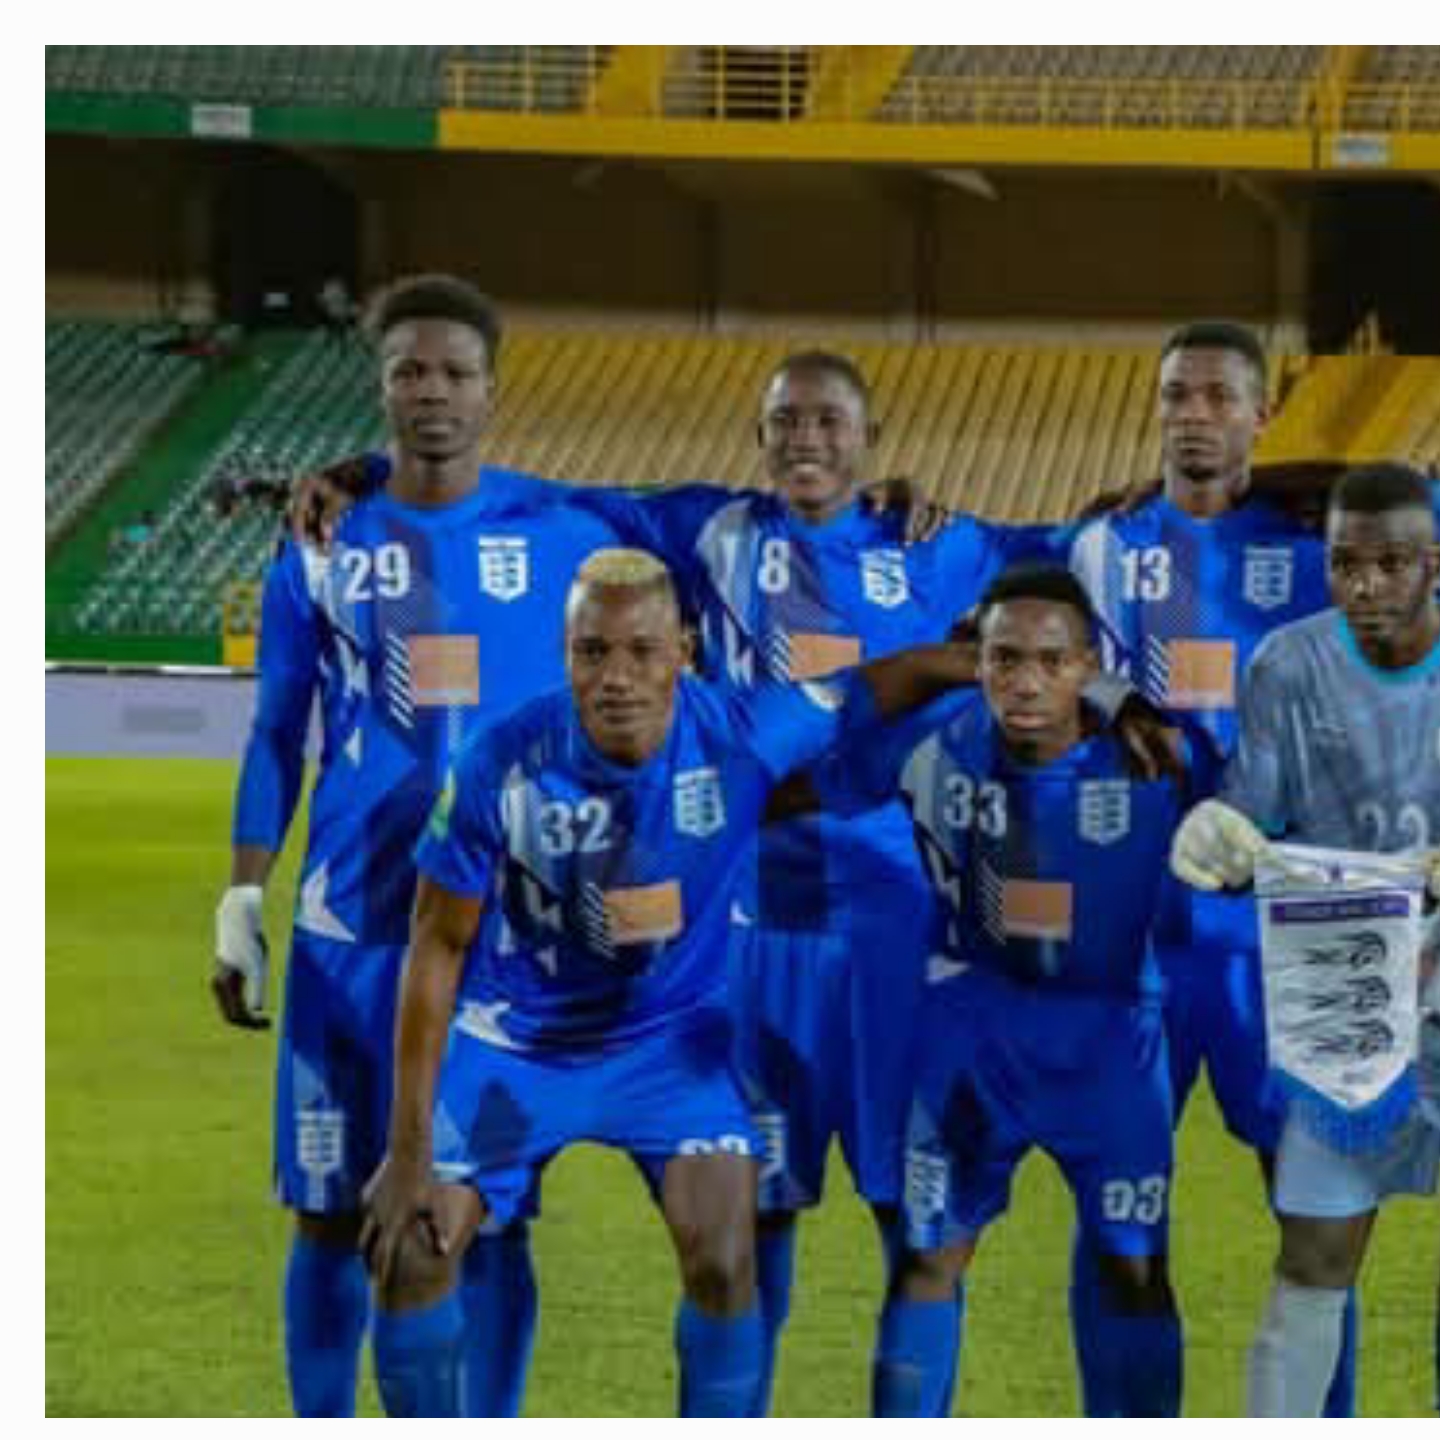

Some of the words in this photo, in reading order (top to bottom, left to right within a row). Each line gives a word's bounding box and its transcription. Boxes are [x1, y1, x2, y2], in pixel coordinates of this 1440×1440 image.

[341, 543, 411, 600] 29
[758, 538, 791, 592] 8
[1120, 546, 1171, 600] 13
[539, 799, 612, 854] 32
[942, 773, 1007, 838] 33
